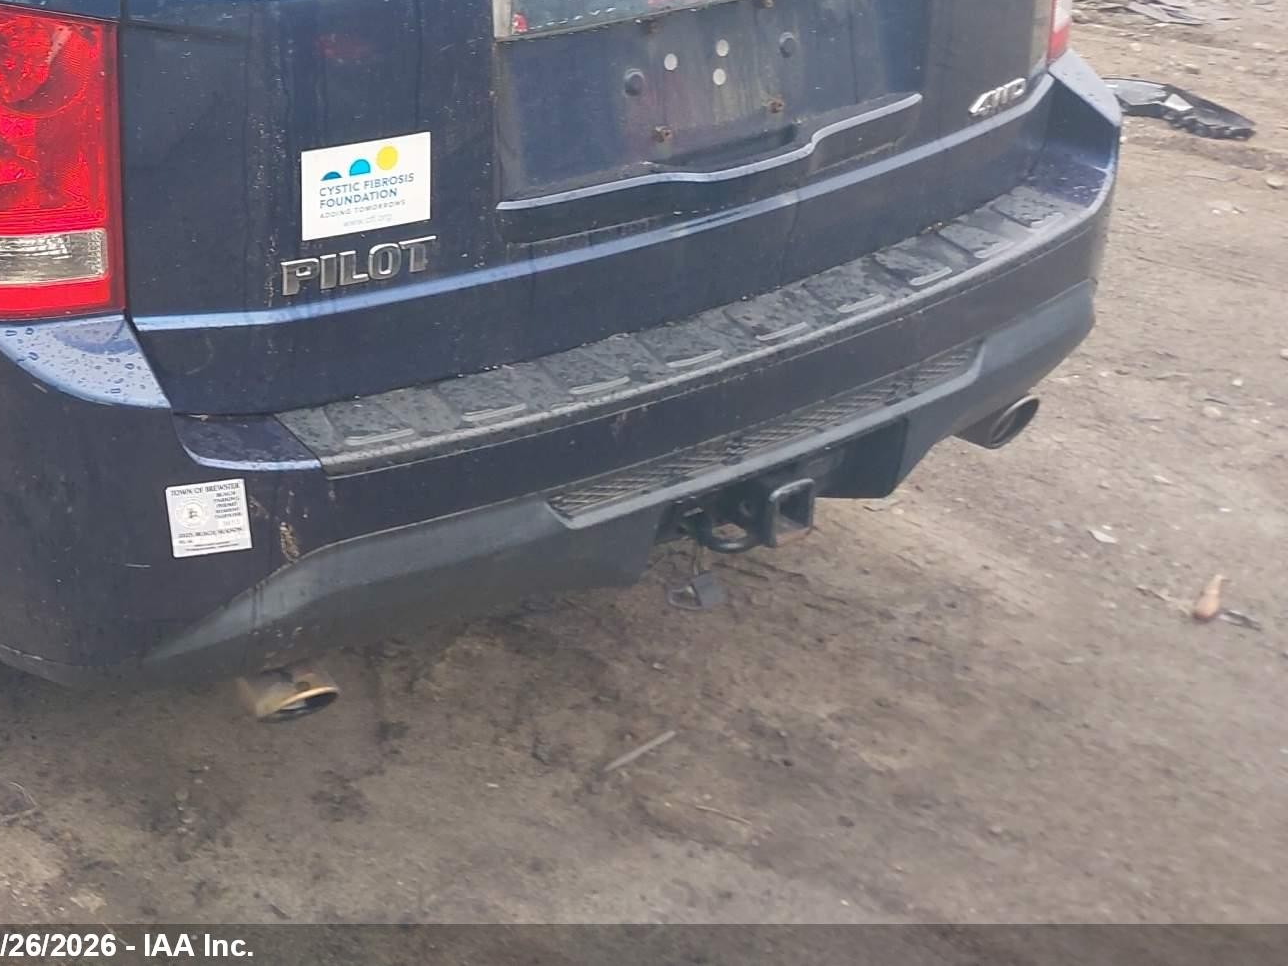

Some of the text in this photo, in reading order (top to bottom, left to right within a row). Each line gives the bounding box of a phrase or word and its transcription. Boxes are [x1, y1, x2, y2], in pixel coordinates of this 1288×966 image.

[319, 173, 415, 197] CYSTIC FIBROSIS
[319, 188, 398, 209] FOUNDATION
[319, 199, 406, 219] ADDING TOMORROWS
[280, 235, 437, 296] PILOT
